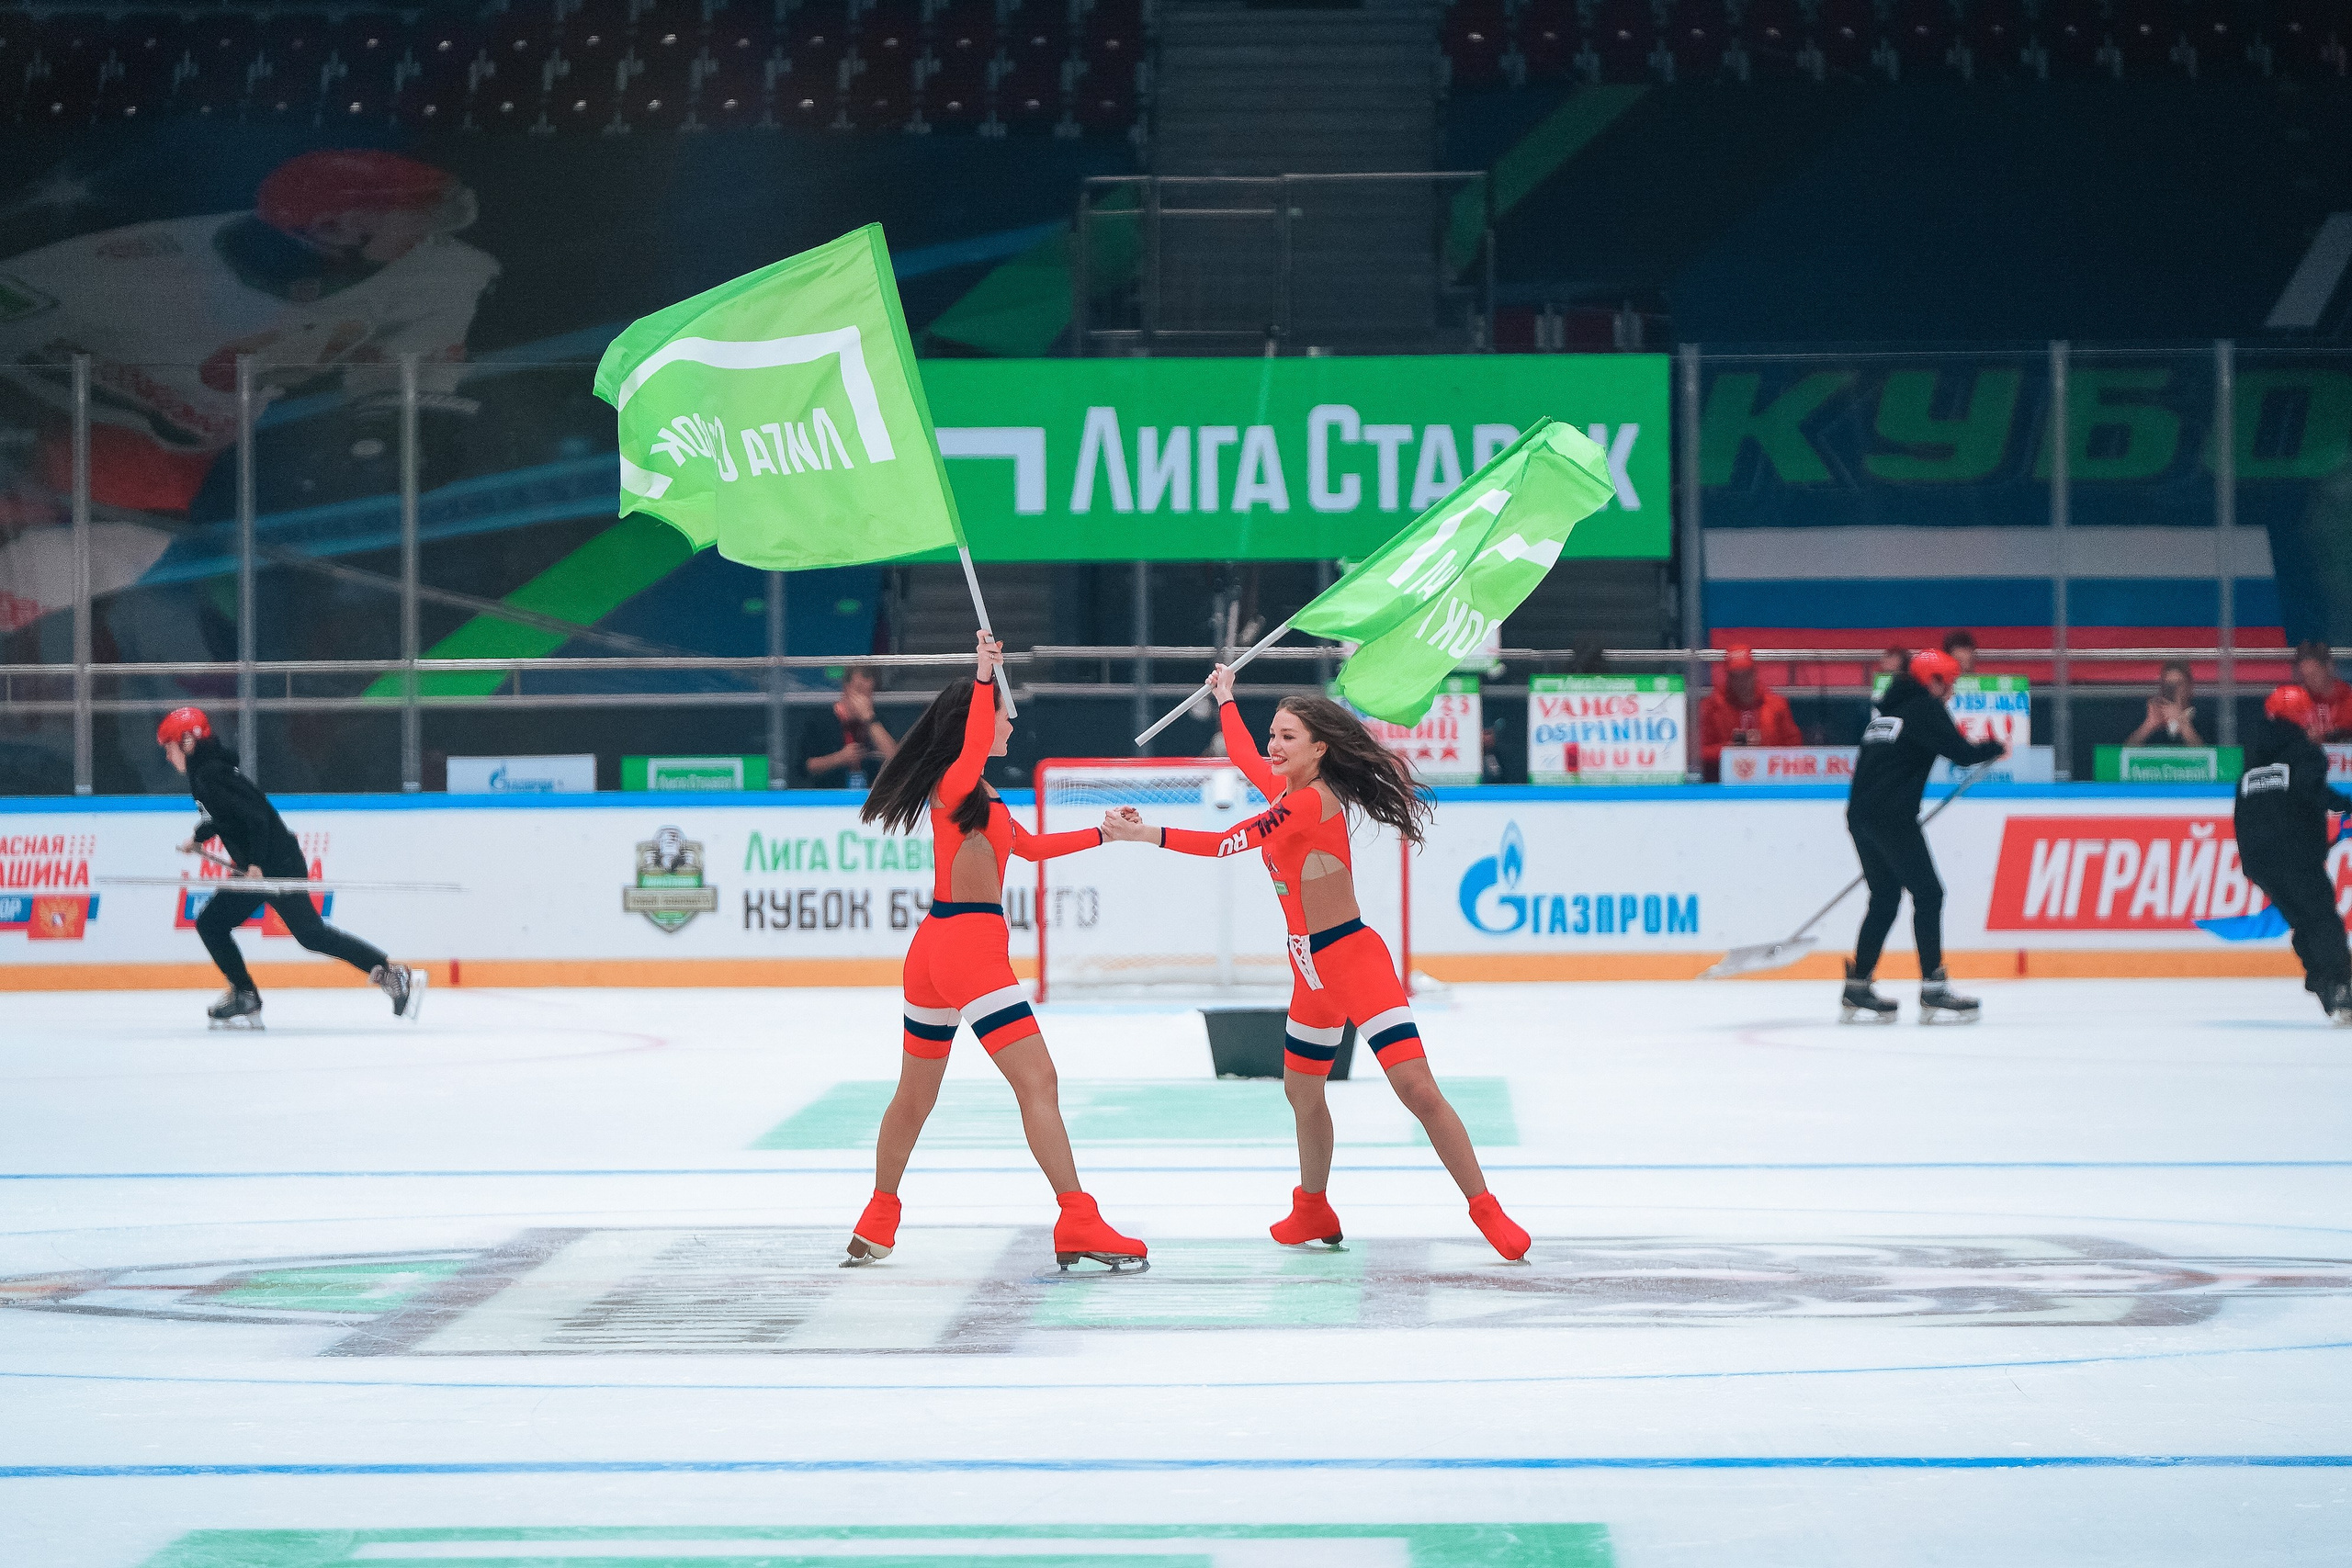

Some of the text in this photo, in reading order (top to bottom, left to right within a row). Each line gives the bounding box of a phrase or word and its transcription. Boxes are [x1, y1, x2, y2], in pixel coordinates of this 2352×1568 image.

[1069, 403, 1642, 513] ЛИГА СТАК
[1536, 694, 1641, 719] VAMOS
[837, 828, 936, 872] СТАВ
[742, 887, 870, 931] КУБОК
[1532, 893, 1699, 933] ГАЗПРОМ
